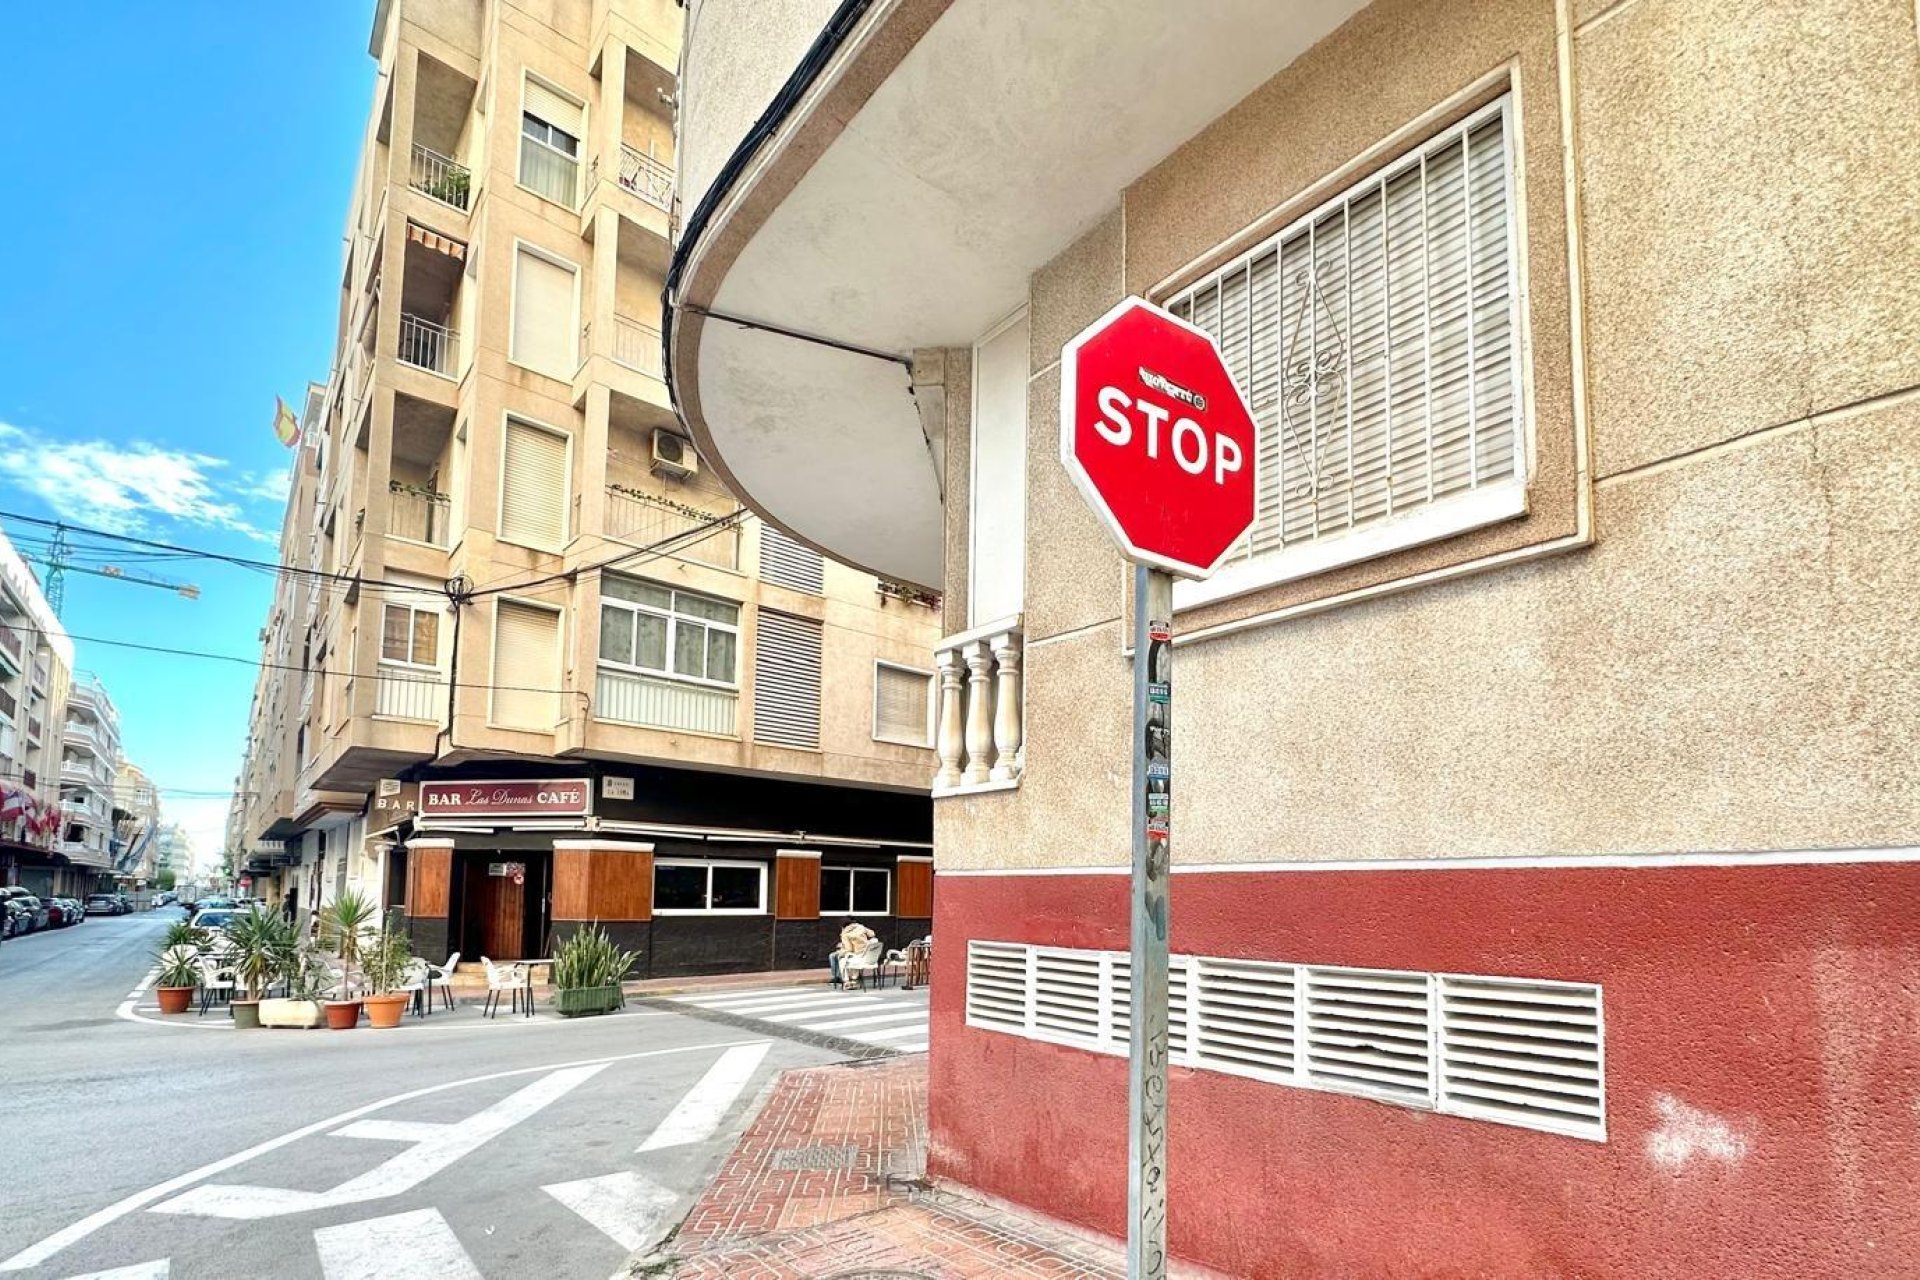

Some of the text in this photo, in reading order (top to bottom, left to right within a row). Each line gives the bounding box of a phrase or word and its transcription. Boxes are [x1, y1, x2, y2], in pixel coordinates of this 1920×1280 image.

[1094, 385, 1243, 485] STOP
[378, 798, 415, 811] BAR
[428, 788, 581, 806] BAR Las Dunas CAFÉ
